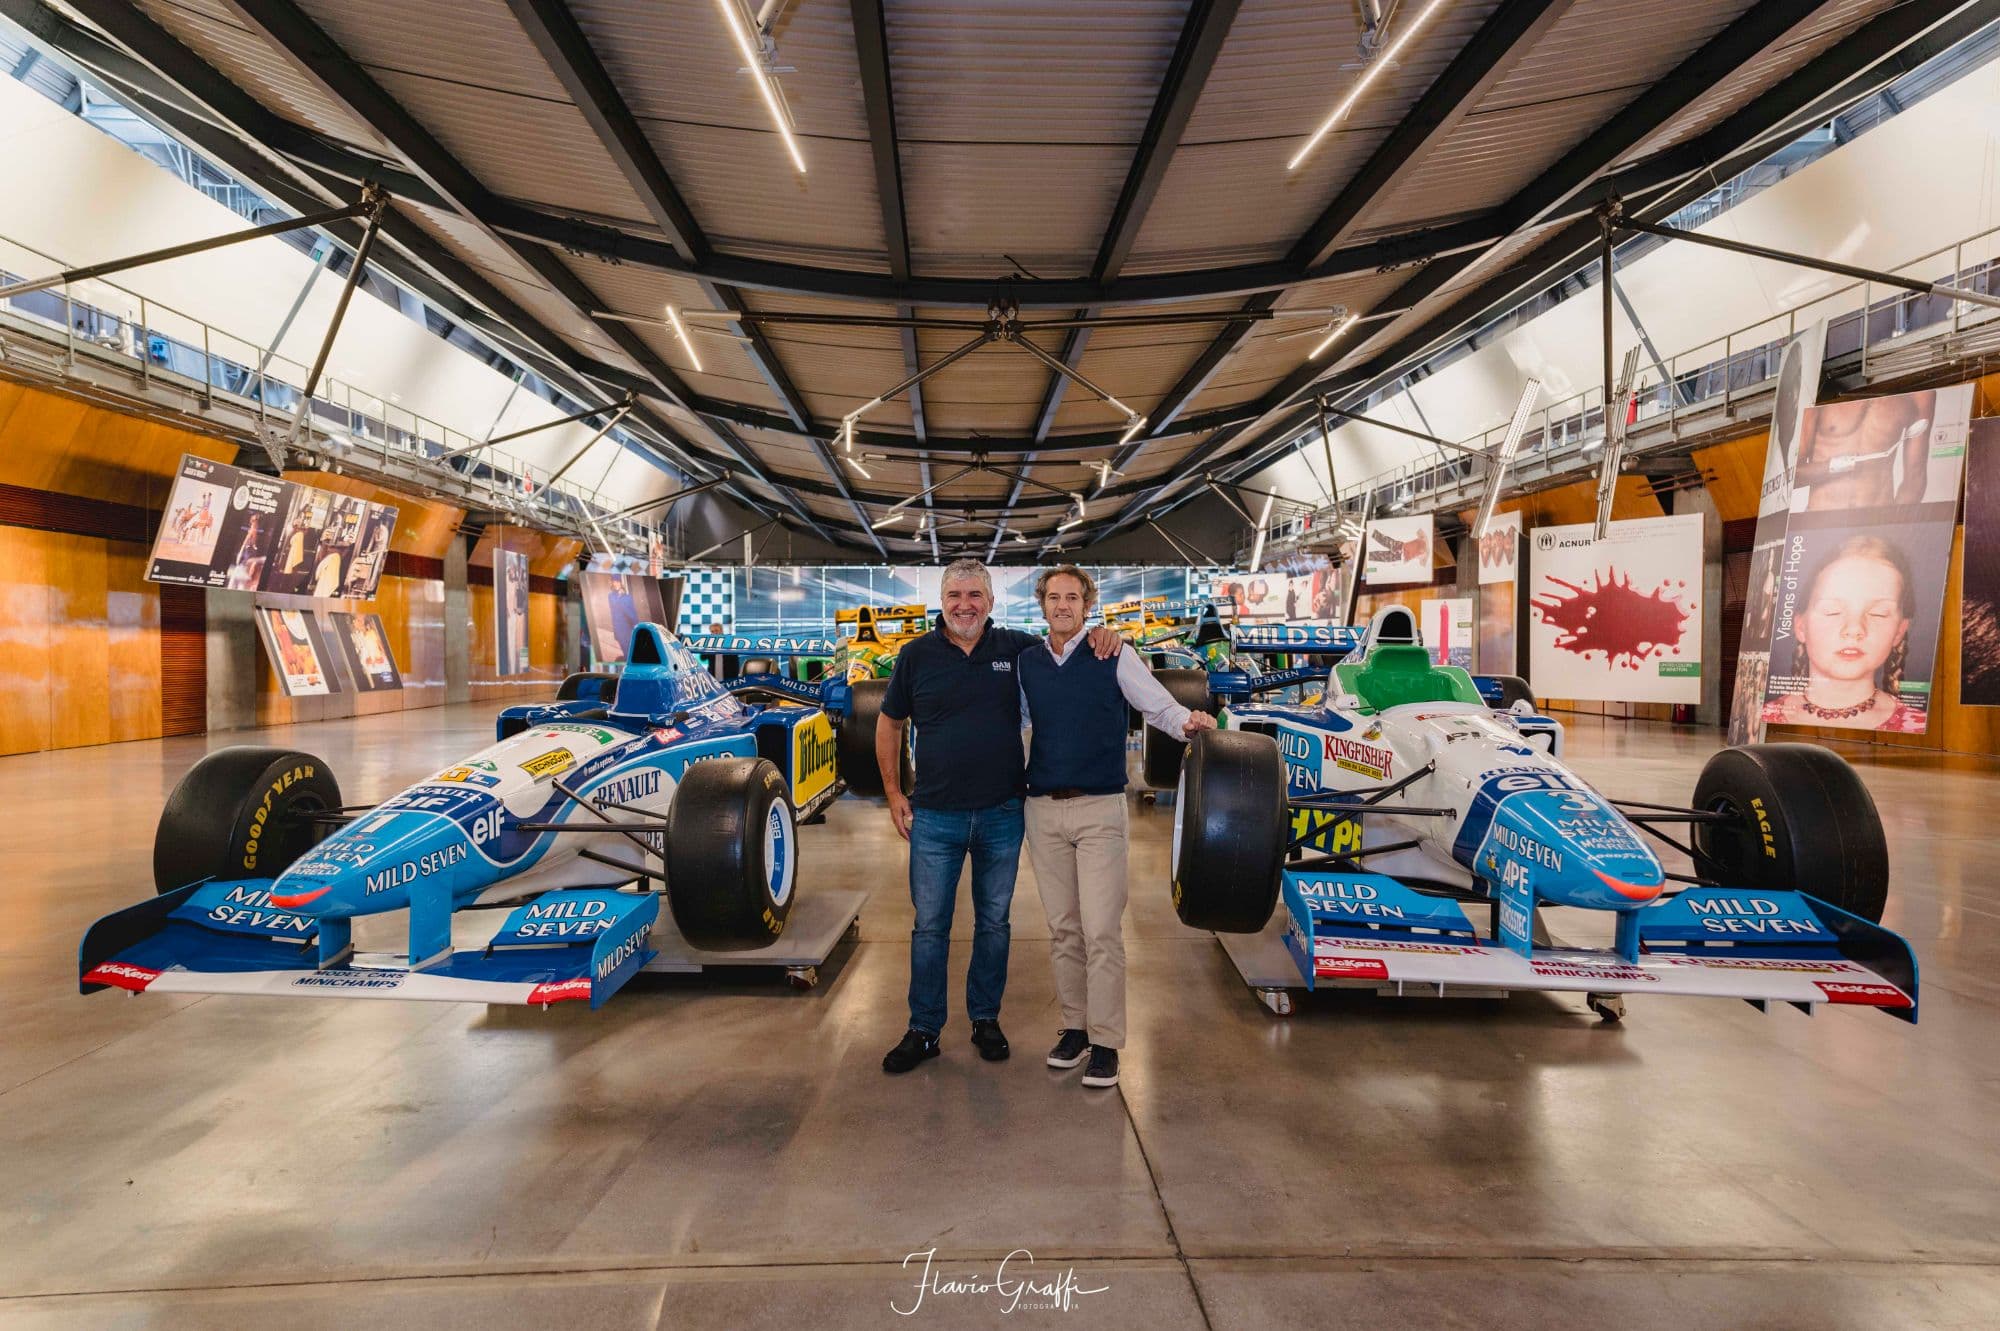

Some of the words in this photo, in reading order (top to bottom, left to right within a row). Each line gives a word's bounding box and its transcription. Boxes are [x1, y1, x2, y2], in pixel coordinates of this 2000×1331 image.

[1559, 539, 1591, 549] ACNUR
[1790, 534, 1805, 566] Hope
[1784, 568, 1799, 586] of
[1775, 587, 1797, 641] Visions
[682, 636, 751, 650] MILD
[756, 638, 837, 653] SEVEN
[1236, 627, 1309, 645] MILD
[1315, 627, 1365, 646] SEV
[1323, 733, 1393, 780] KINGFISHER
[1285, 761, 1319, 792] VEN
[597, 769, 662, 812] RENAULT
[1547, 790, 1599, 812] 3
[359, 813, 401, 834] 1
[473, 806, 505, 846] elf
[1751, 797, 1776, 860] EAGLE
[1493, 821, 1518, 852] MILD
[1519, 834, 1563, 873] SEVEN
[365, 861, 417, 896] MILD
[419, 840, 468, 877] SEVEN
[1502, 858, 1529, 896] APE
[223, 886, 272, 911] MIL
[1296, 879, 1378, 900] MILD
[207, 904, 316, 933] SEVEN
[524, 899, 607, 920] MILD
[1306, 898, 1405, 919] SEVEN
[1685, 898, 1782, 917] MILD
[515, 914, 618, 939] SEVEN
[1702, 917, 1822, 935] SEVEN
[313, 970, 361, 978] MODEL
[598, 945, 624, 983] MILD
[1529, 960, 1592, 969] MODEL
[1534, 967, 1657, 981] MINICHAMPS
[295, 978, 401, 988] MINICHAMPS
